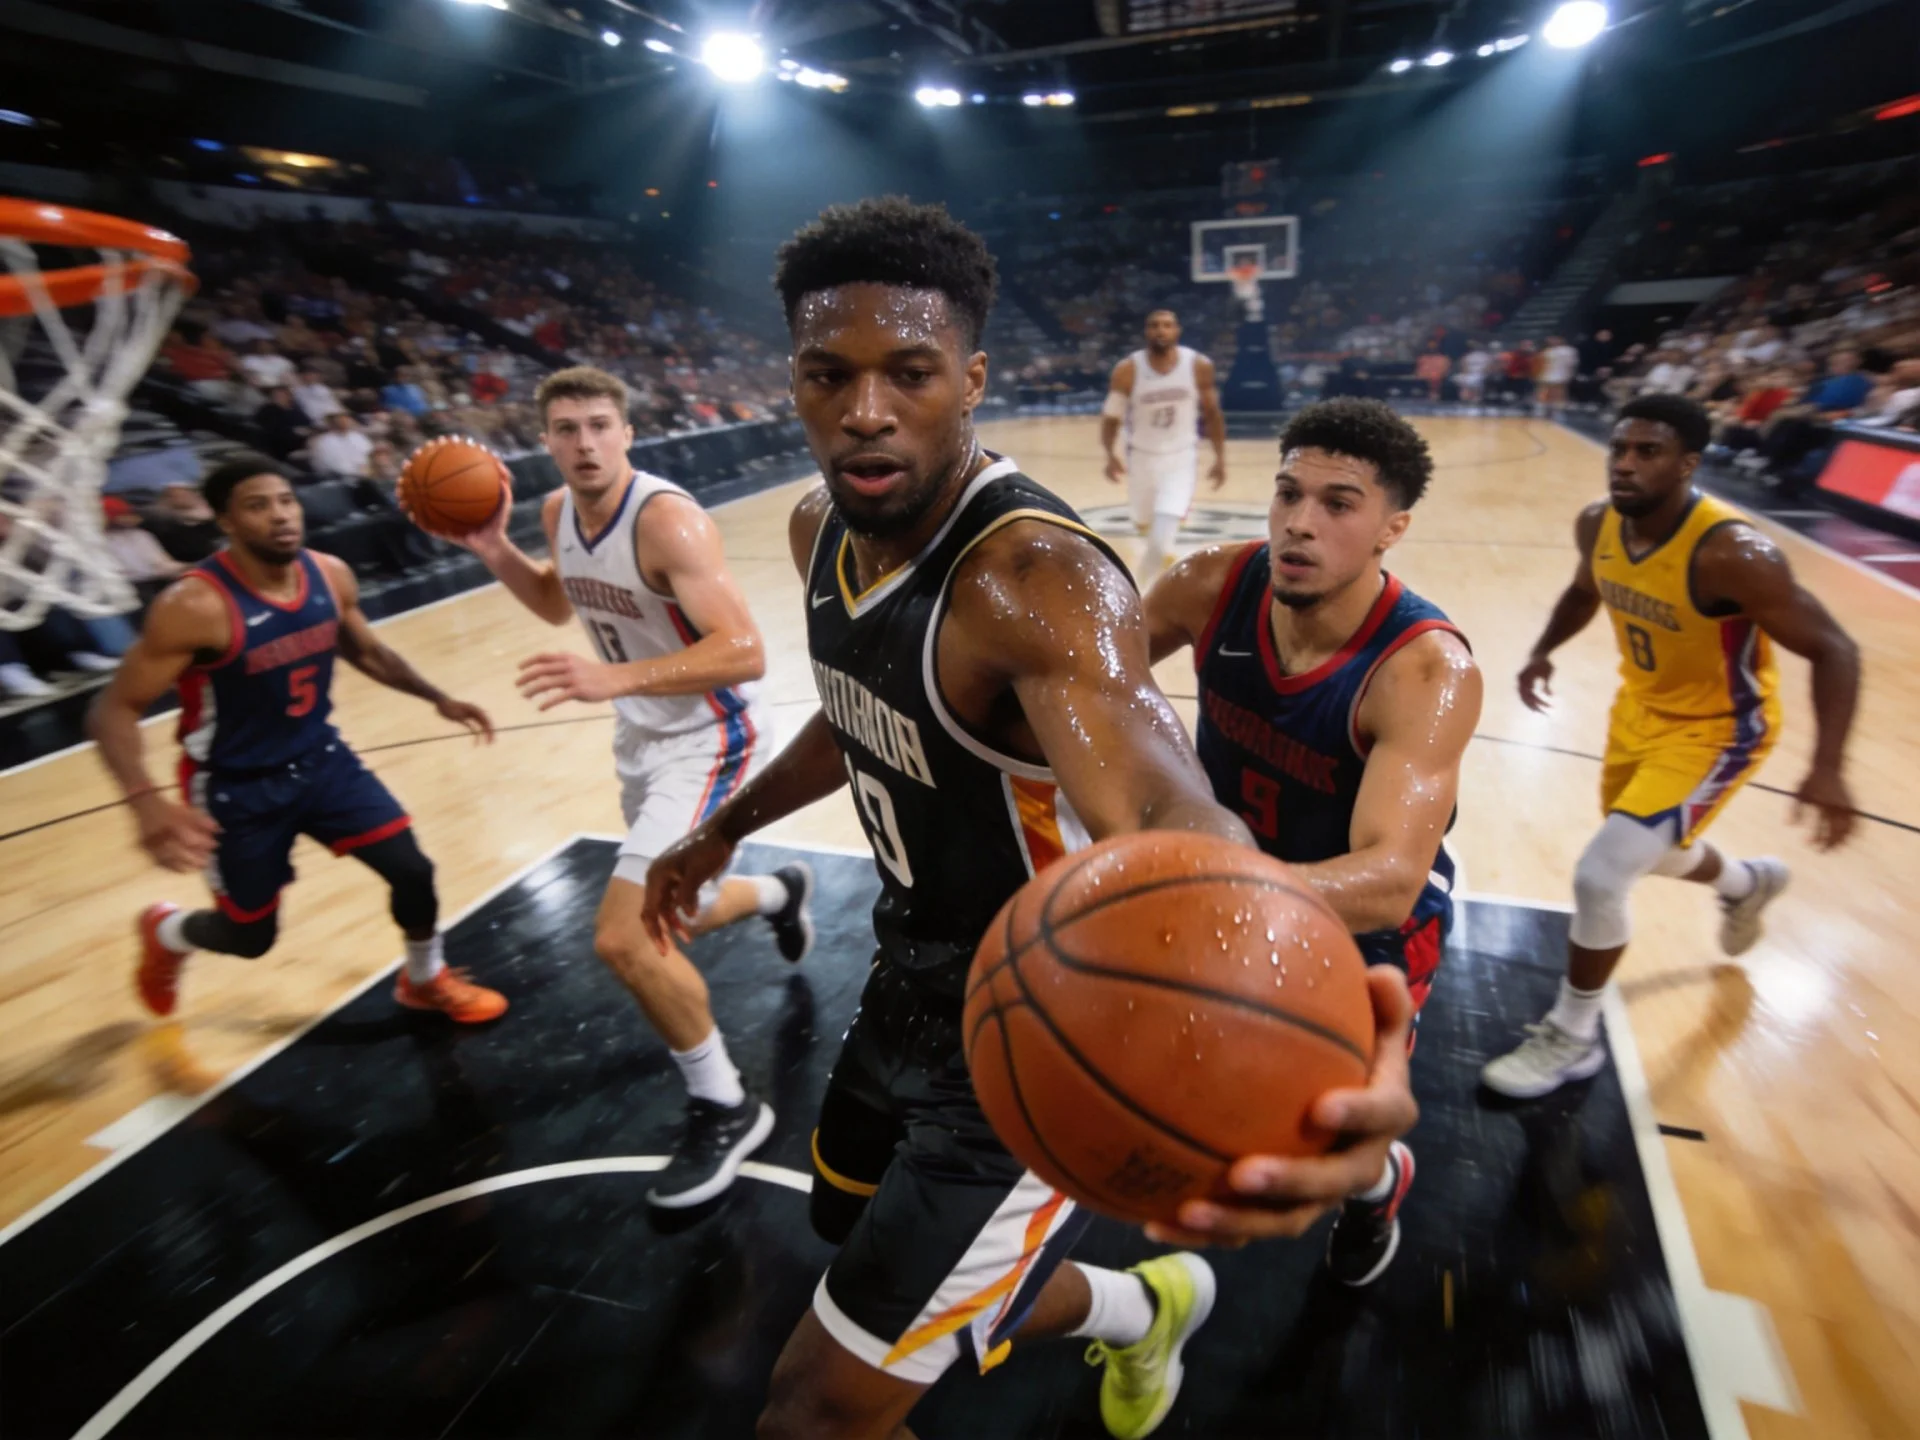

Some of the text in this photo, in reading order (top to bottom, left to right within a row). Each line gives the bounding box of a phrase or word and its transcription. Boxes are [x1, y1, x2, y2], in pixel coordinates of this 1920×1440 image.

[1626, 622, 1657, 673] 8
[285, 665, 320, 718] 5
[1241, 766, 1281, 840] 9
